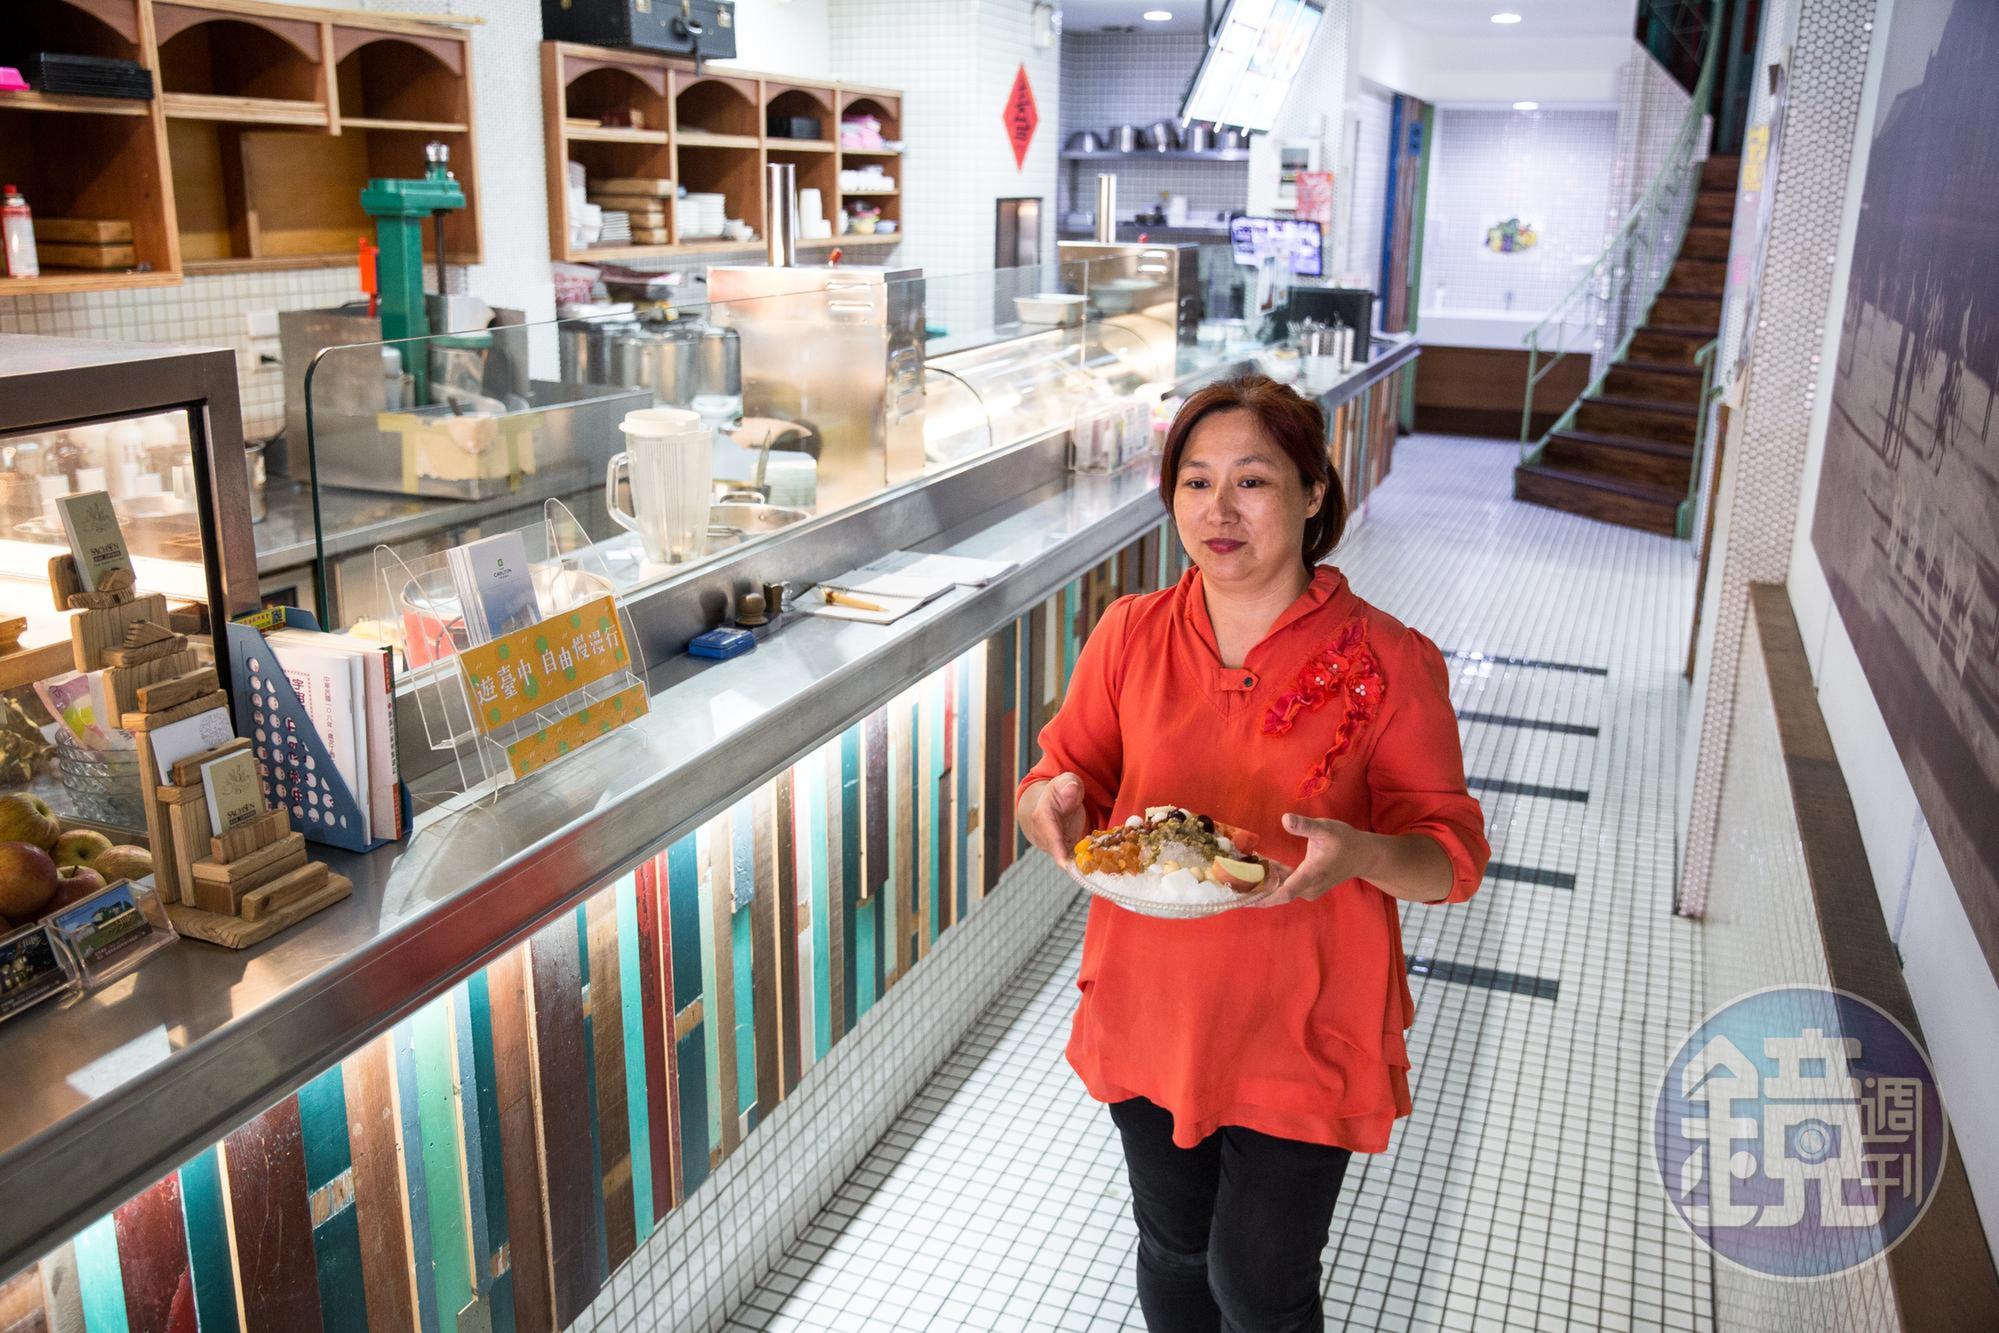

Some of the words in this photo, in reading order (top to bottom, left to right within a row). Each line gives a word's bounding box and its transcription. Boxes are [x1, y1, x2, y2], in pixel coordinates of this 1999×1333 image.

[477, 658, 532, 705] 遊臺中
[540, 624, 620, 676] 自由慢漫行
